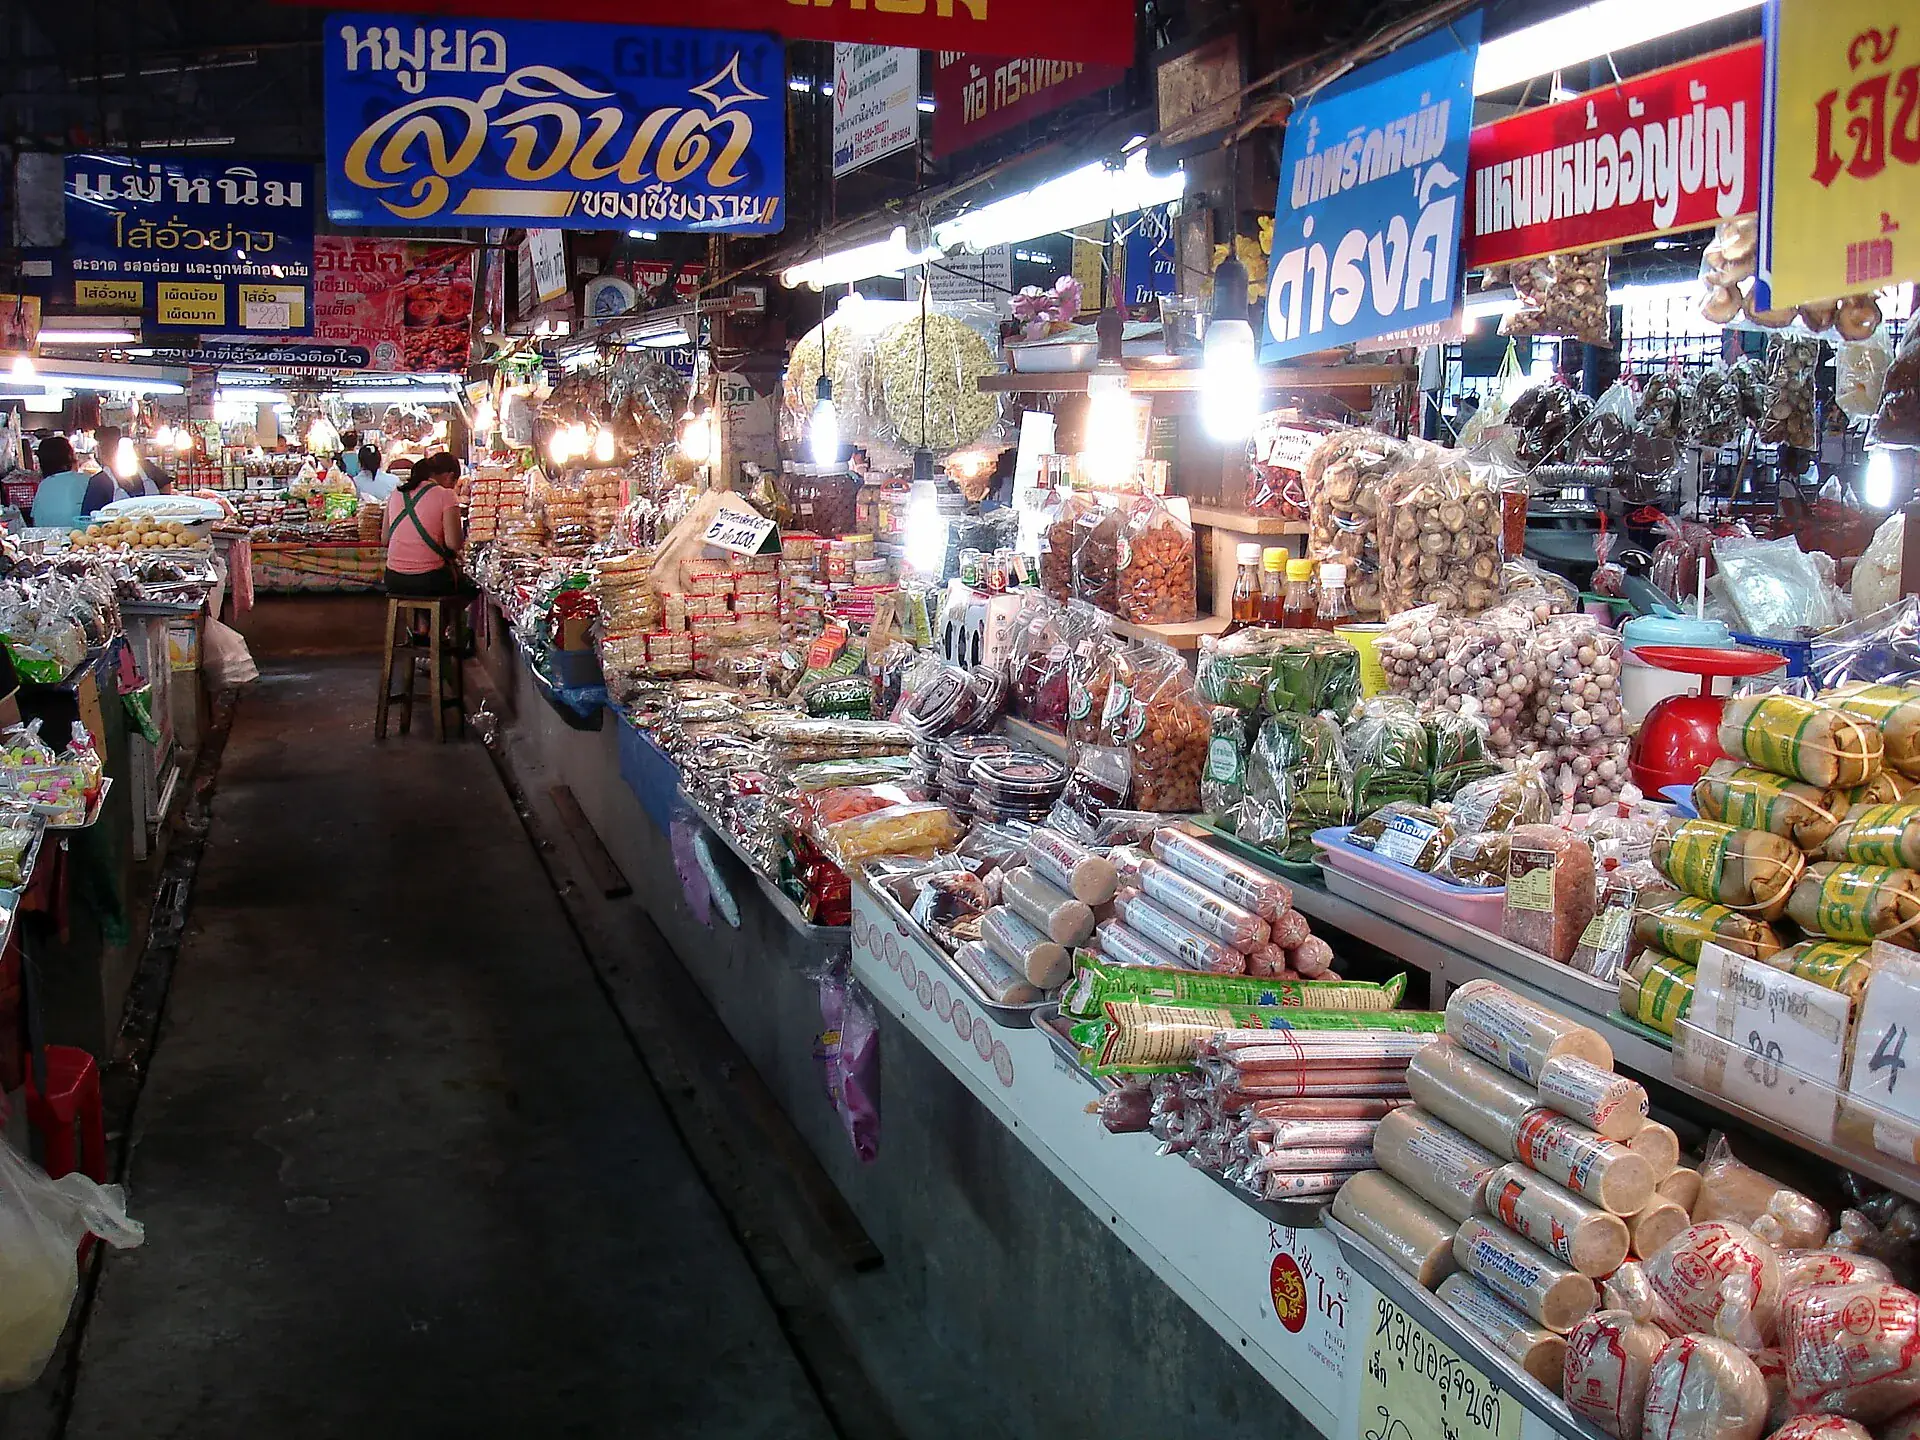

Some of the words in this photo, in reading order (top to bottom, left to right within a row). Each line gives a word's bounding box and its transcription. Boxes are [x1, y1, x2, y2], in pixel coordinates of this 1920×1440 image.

[341, 25, 507, 94] หมูยอ
[1291, 91, 1450, 210] น้ำพริกหนุ่ม
[1475, 80, 1746, 230] แหนมหม้ออัญชัญ
[75, 164, 302, 207] แม่หนิม
[581, 182, 764, 224] ของเชียงราย
[108, 211, 274, 252] ไส้อั่วย่าง
[1847, 211, 1899, 285] แท้
[72, 258, 117, 272] สะอาด
[124, 258, 179, 273] รสอร่อย
[83, 284, 137, 303] ไส้อั่วหมู
[164, 287, 218, 302] เผ็ดน้อย
[166, 306, 216, 320] เผ็ดมาก
